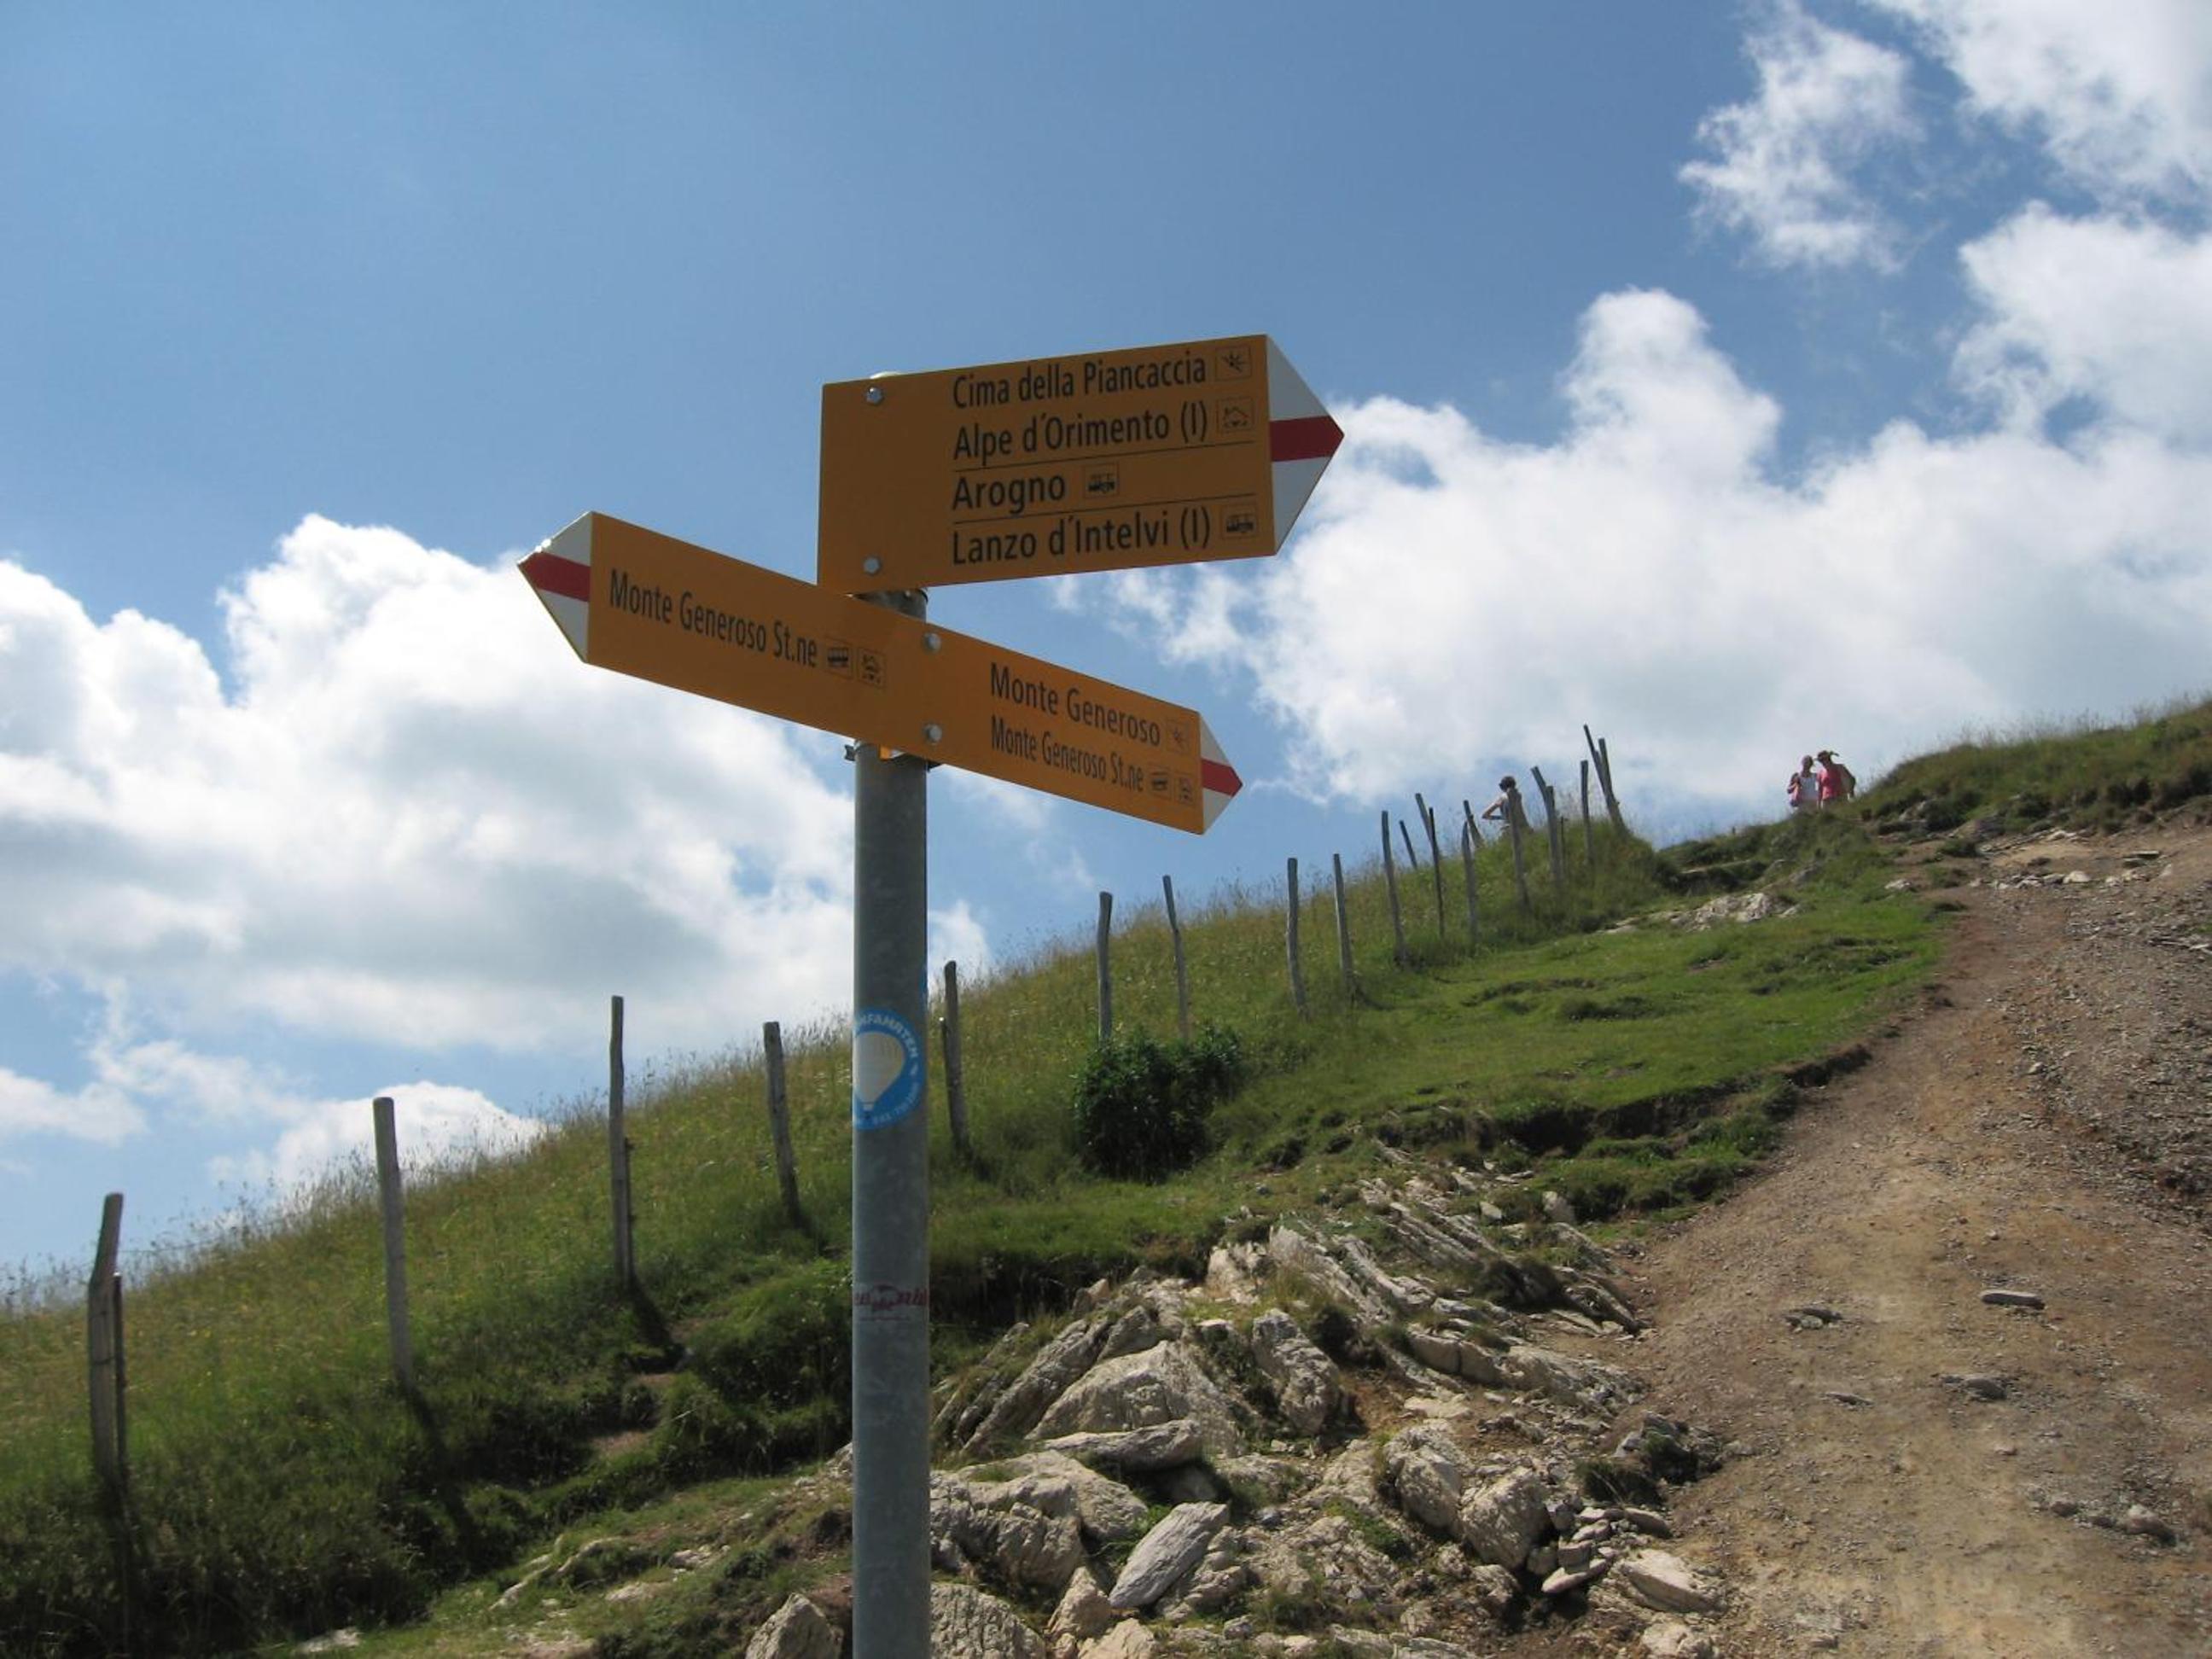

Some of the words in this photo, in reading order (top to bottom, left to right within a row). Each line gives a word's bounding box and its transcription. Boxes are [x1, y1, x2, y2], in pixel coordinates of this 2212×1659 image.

[953, 373, 1010, 408] Cima
[1019, 364, 1074, 402] della
[1084, 352, 1206, 393] Piancaccia
[953, 426, 1011, 468] Alpe
[952, 474, 1065, 515] Arogno
[953, 529, 1035, 565] Lanzo
[610, 568, 672, 624] Monte
[680, 591, 765, 652] Generoso
[773, 620, 816, 667] St.ne
[991, 661, 1058, 714] Monte
[1067, 688, 1160, 746] Generoso
[992, 715, 1036, 761] Monte
[1042, 731, 1106, 779] Generoso
[1111, 752, 1144, 791] St.ne
